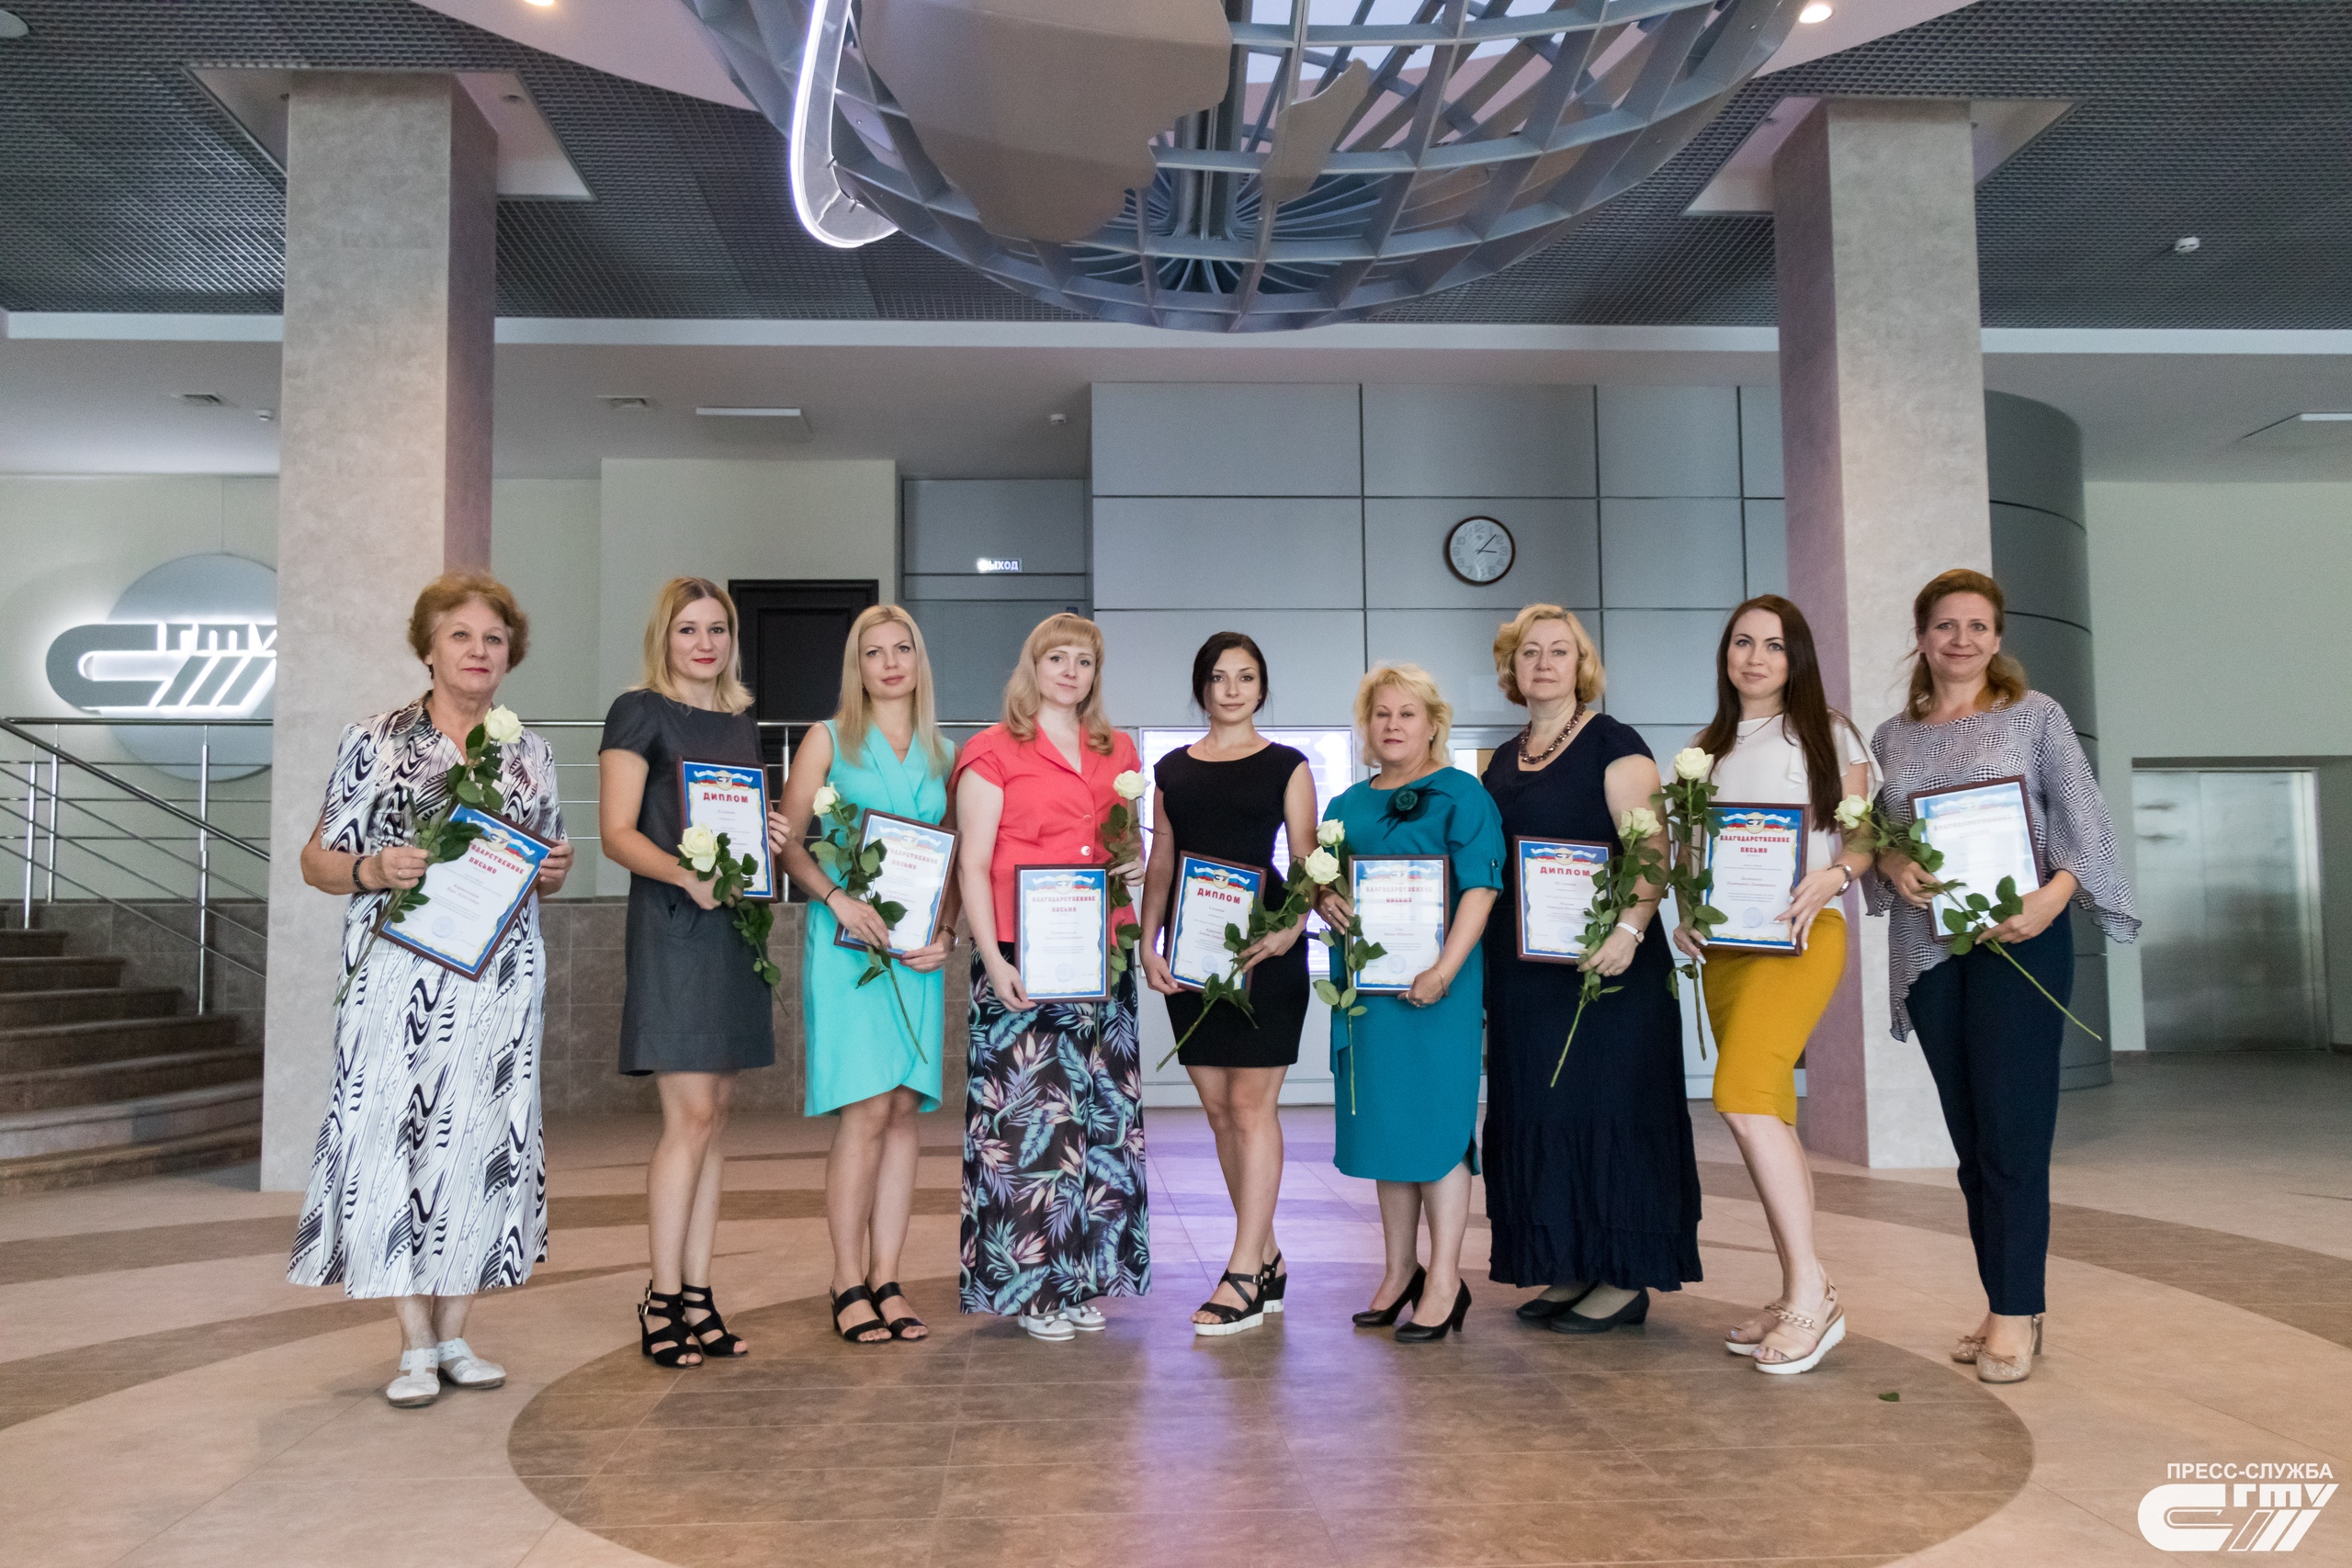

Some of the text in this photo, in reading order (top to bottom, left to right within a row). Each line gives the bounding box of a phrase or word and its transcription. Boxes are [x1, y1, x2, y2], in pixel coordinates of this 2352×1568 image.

[978, 558, 1019, 570] ЫХОД
[704, 792, 748, 803] ДИПЛОМ
[1720, 835, 1791, 843] БЛАГОДАРСТВЕННОЕ
[469, 841, 525, 874] ОДАРСТВЕННОЕ
[469, 856, 497, 874] ПИСЬМО
[1540, 866, 1591, 876] ДИПЛОМ
[1197, 887, 1240, 904] ДИПЛОМ
